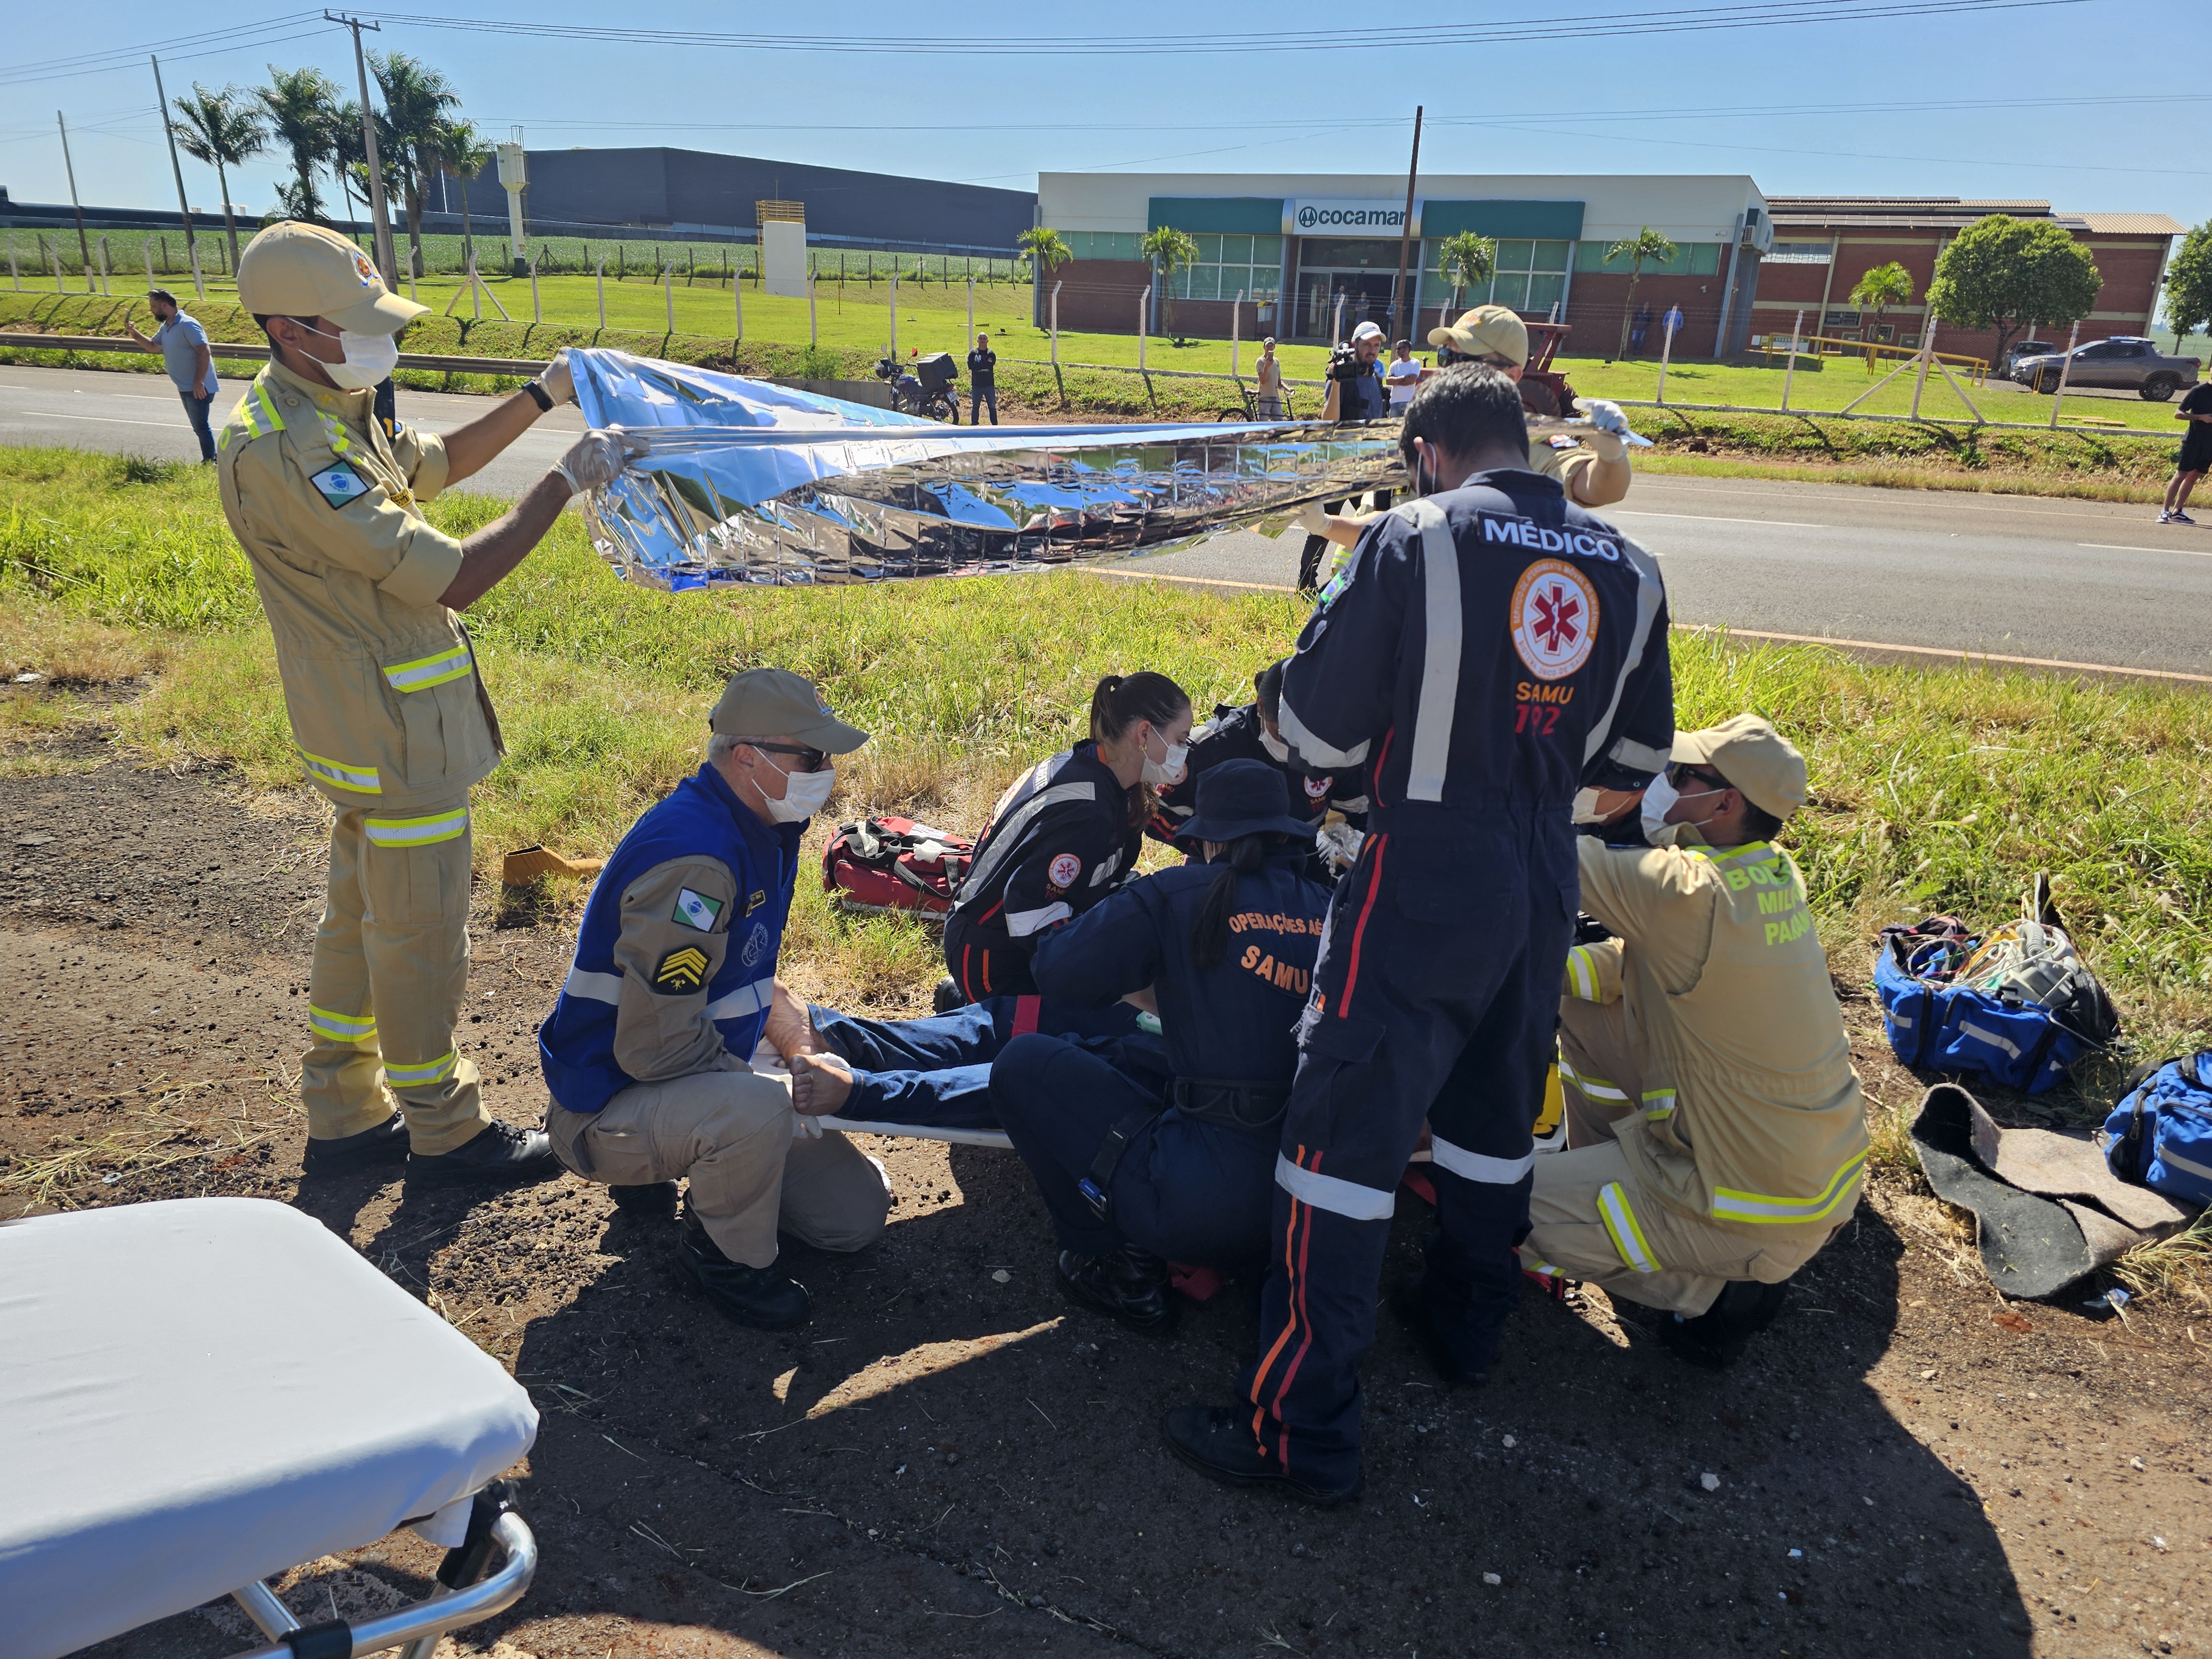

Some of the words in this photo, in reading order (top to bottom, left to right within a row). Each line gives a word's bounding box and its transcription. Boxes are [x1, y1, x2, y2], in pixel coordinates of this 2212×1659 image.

[1318, 210, 1406, 226] cocamar
[1484, 519, 1619, 561] MÉDICO
[1515, 681, 1574, 705] SAMU
[1514, 704, 1561, 737] 192
[1229, 912, 1307, 935] OPERAÇÕES
[1309, 919, 1323, 936] AÉ
[1241, 946, 1308, 994] SAMU
